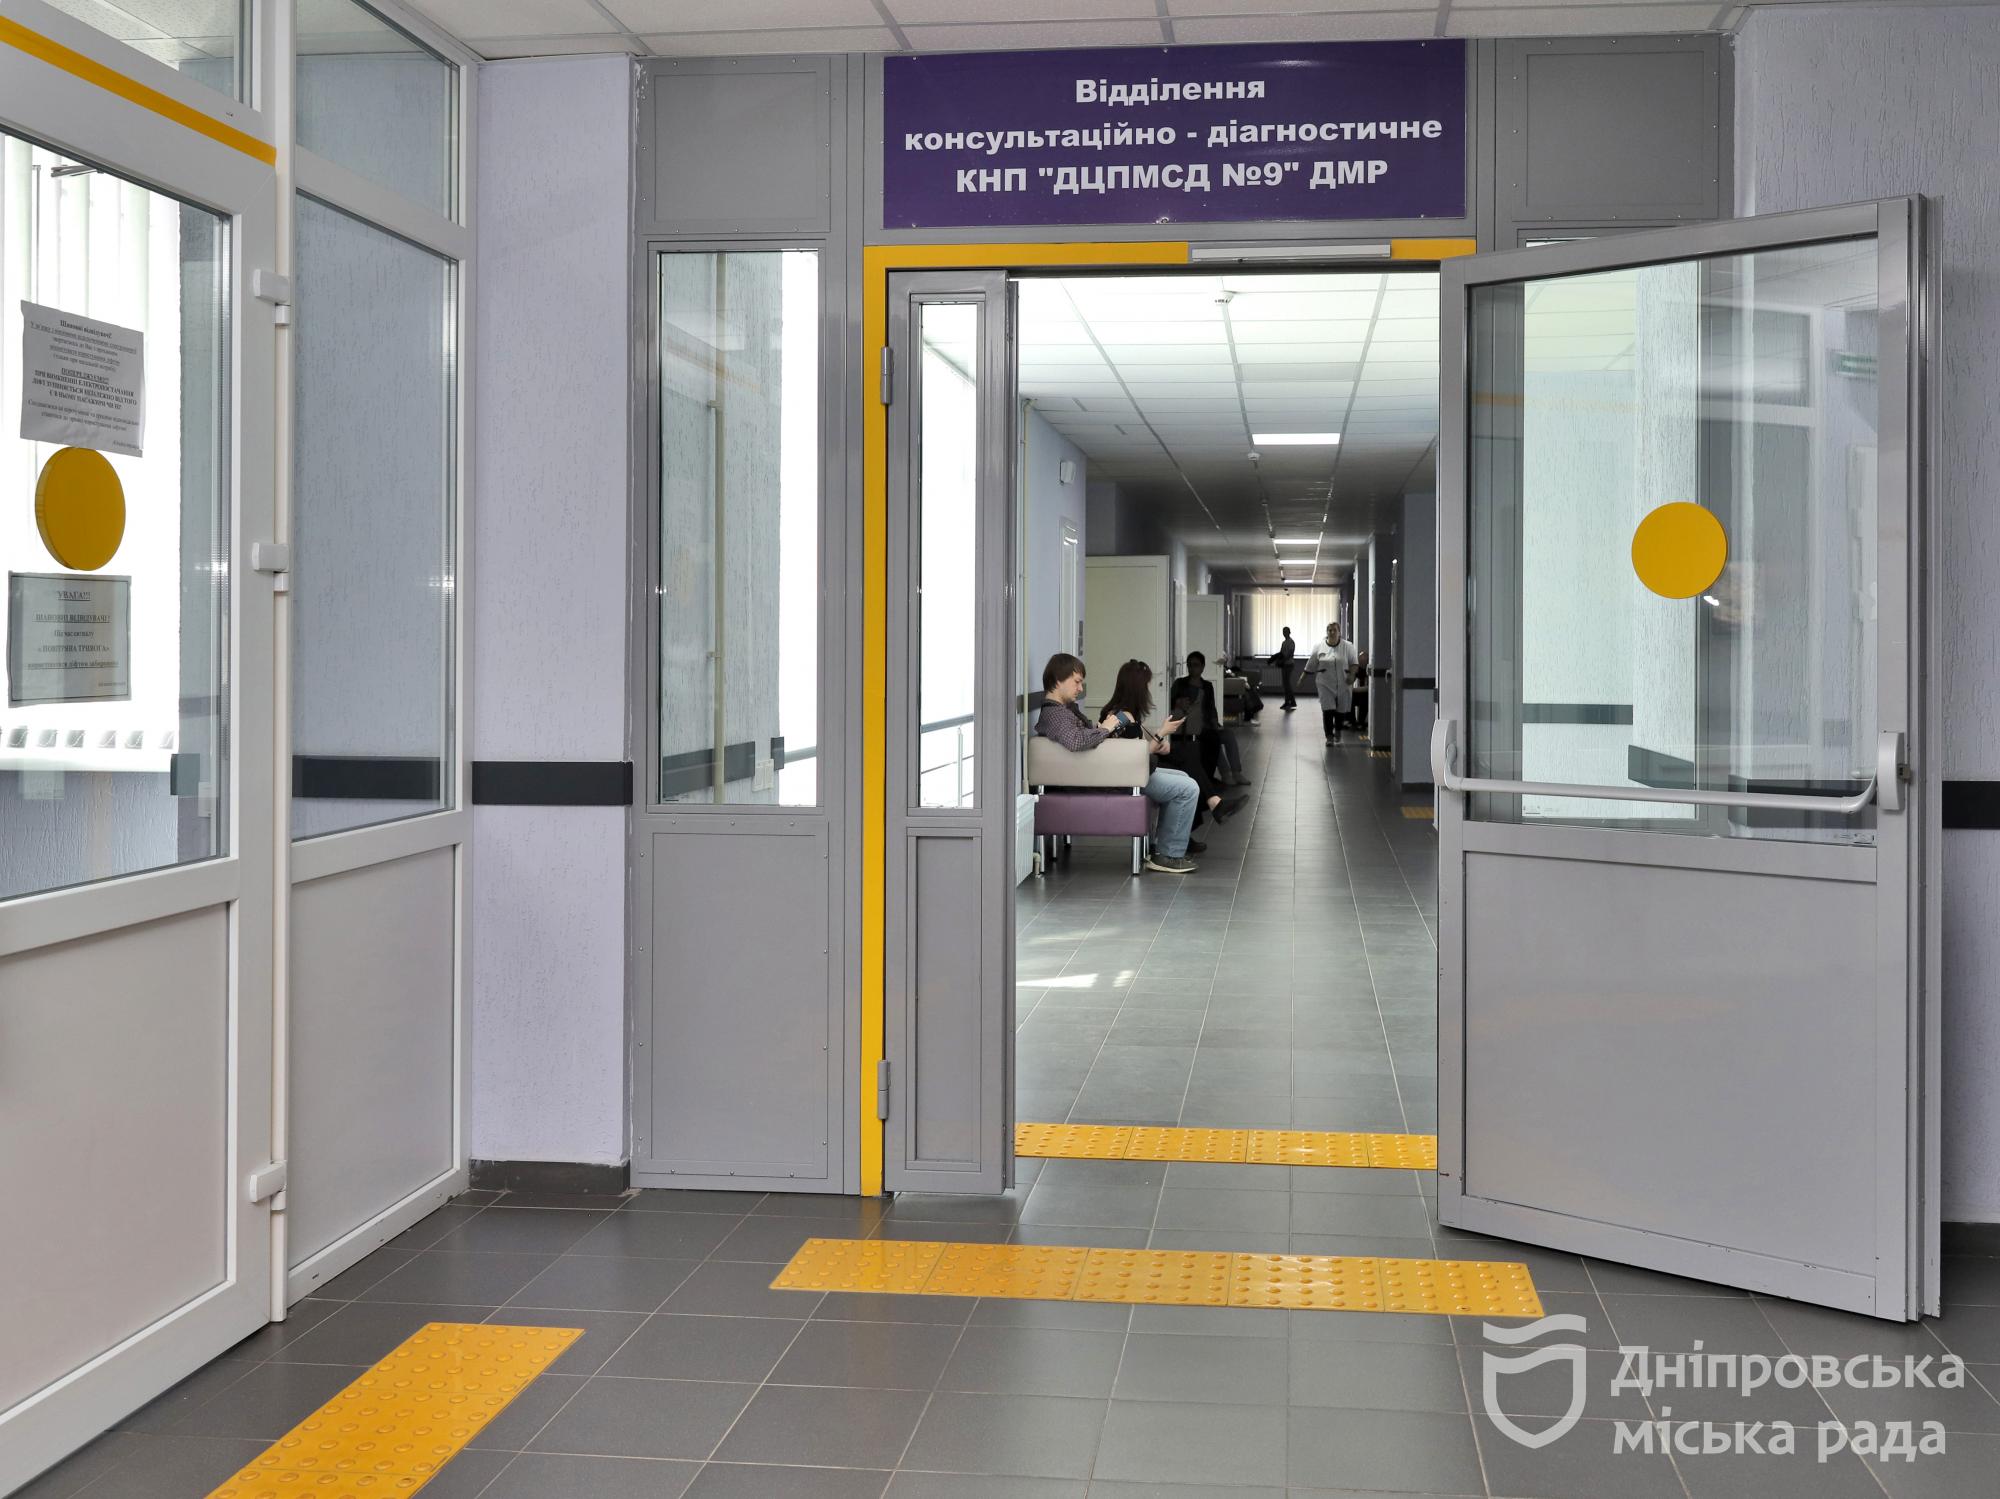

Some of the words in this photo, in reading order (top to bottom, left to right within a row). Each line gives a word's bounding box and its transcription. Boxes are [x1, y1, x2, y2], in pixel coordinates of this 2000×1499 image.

[1076, 77, 1265, 107] Відділення
[905, 121, 1176, 153] консультаційно
[1207, 119, 1443, 148] діагностичне
[956, 167, 1027, 193] КНП
[1038, 163, 1211, 195] "ДЦПМСД
[1222, 161, 1300, 187] №9"
[1309, 159, 1388, 190] ДМР
